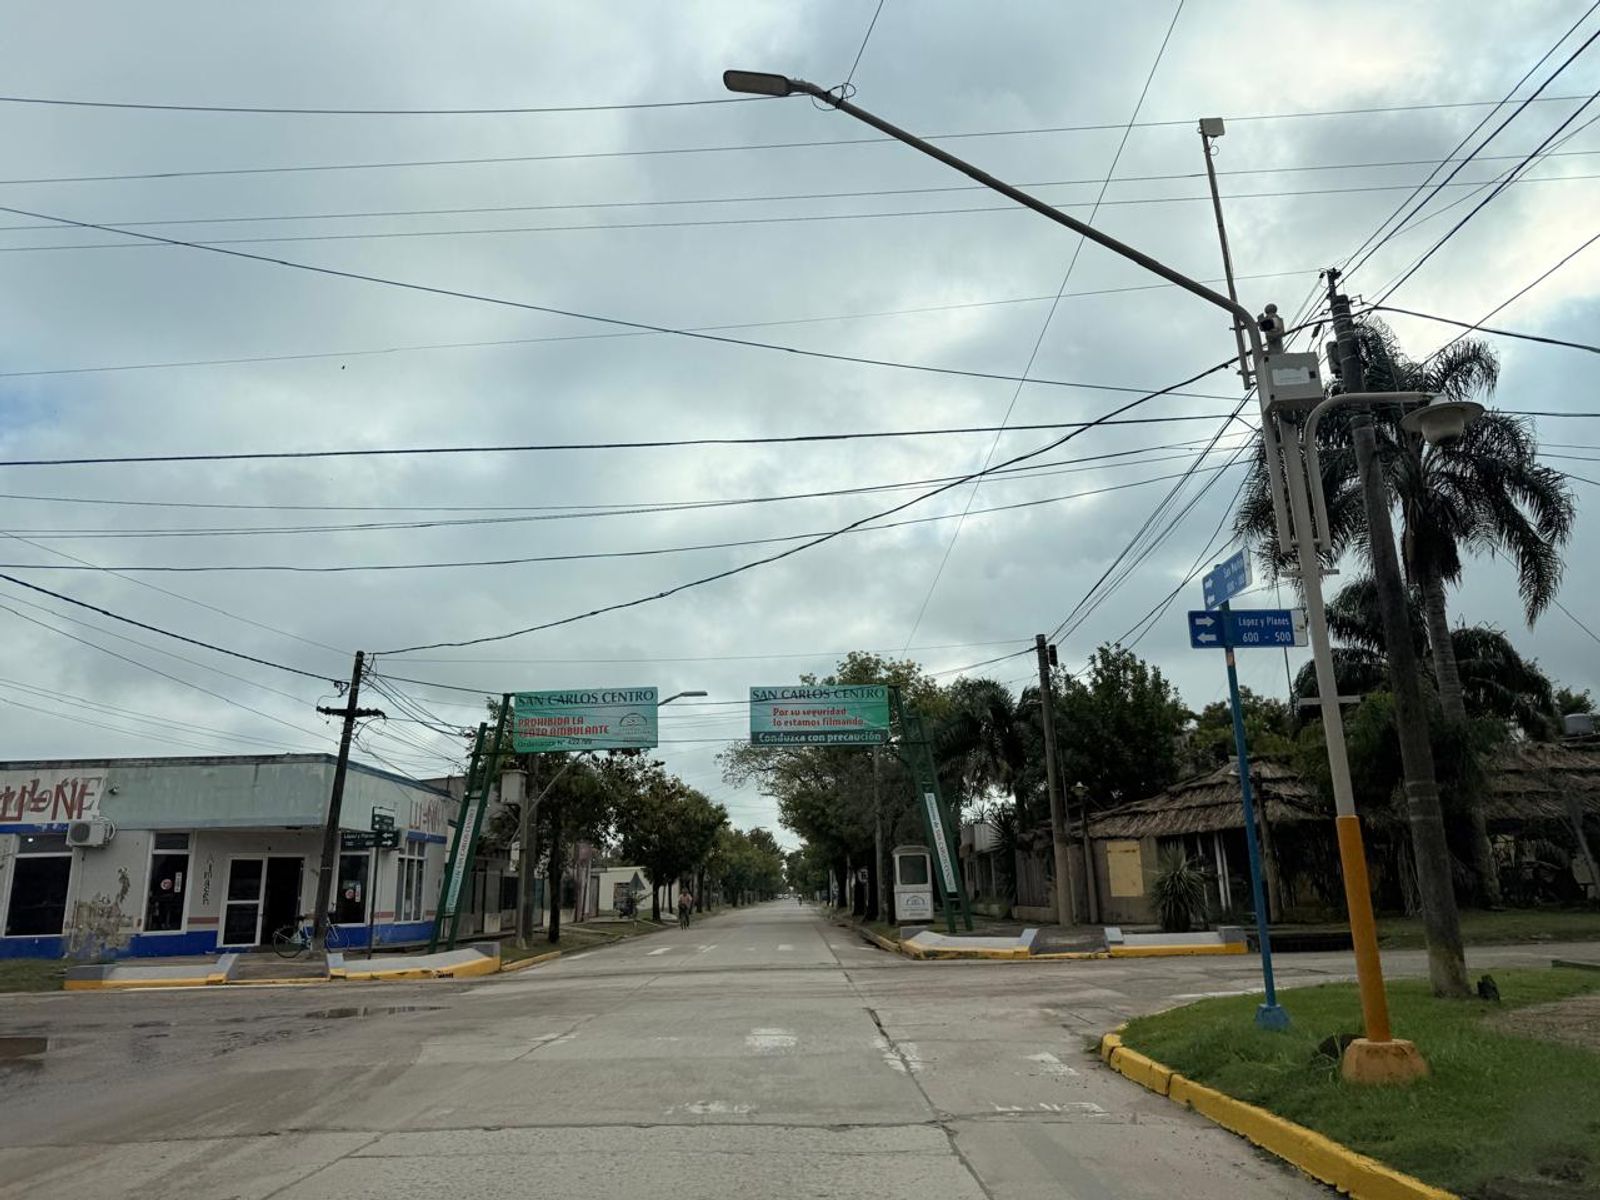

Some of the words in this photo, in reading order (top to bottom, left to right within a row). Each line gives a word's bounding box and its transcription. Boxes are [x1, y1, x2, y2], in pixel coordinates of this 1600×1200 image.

[1260, 618, 1265, 627] y
[1266, 616, 1290, 625] Planes
[1242, 632, 1259, 642] 600
[1274, 631, 1292, 642] 500
[517, 695, 544, 706] SAN
[548, 692, 599, 705] CARLOS
[602, 690, 654, 704] CENTRO
[752, 689, 778, 700] SAN
[781, 688, 830, 699] CARLOS
[835, 687, 885, 699] CENTRO
[772, 707, 789, 716] Por
[802, 706, 847, 717] seguridad
[772, 718, 782, 727] lo
[784, 718, 820, 727] estamos
[822, 717, 864, 726] filmando
[759, 732, 805, 743] Conduzca
[807, 734, 825, 742] con
[827, 731, 881, 743] precaución
